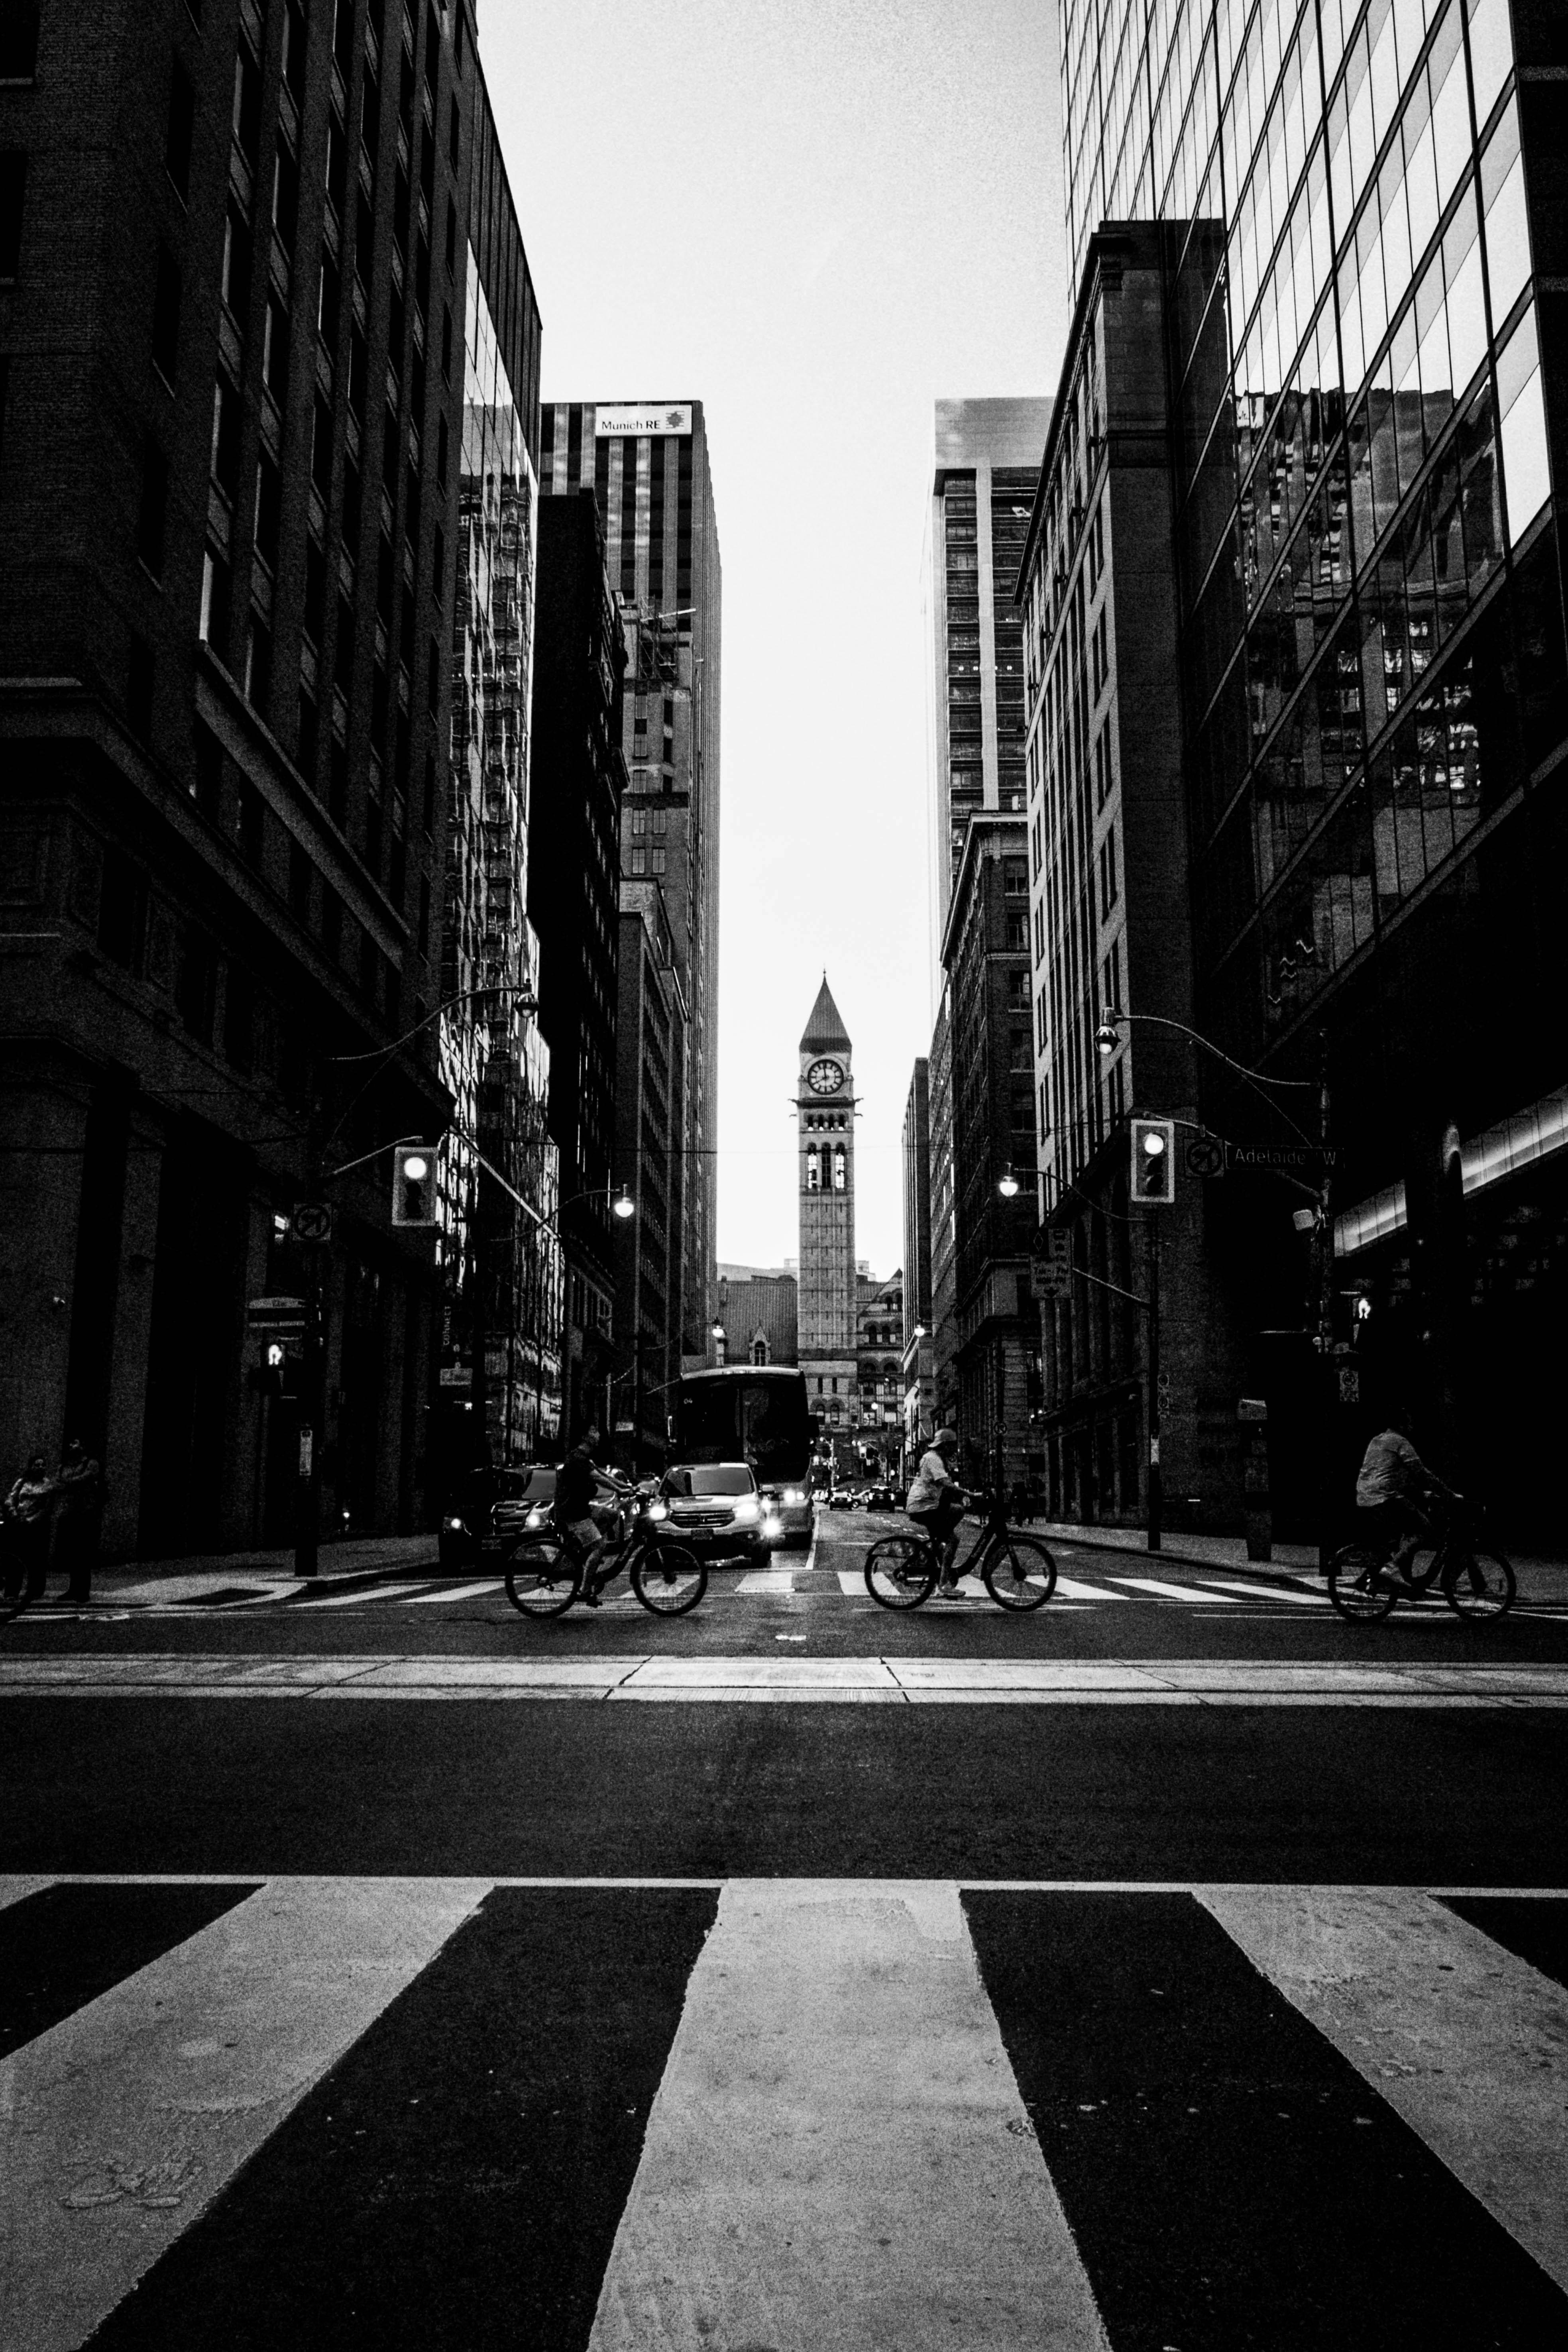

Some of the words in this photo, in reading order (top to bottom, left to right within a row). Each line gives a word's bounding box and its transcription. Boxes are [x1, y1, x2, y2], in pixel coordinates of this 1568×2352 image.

[601, 420, 643, 430] Munich
[646, 420, 661, 429] RE
[1234, 1148, 1307, 1165] Adelaide
[1322, 1150, 1336, 1166] W
